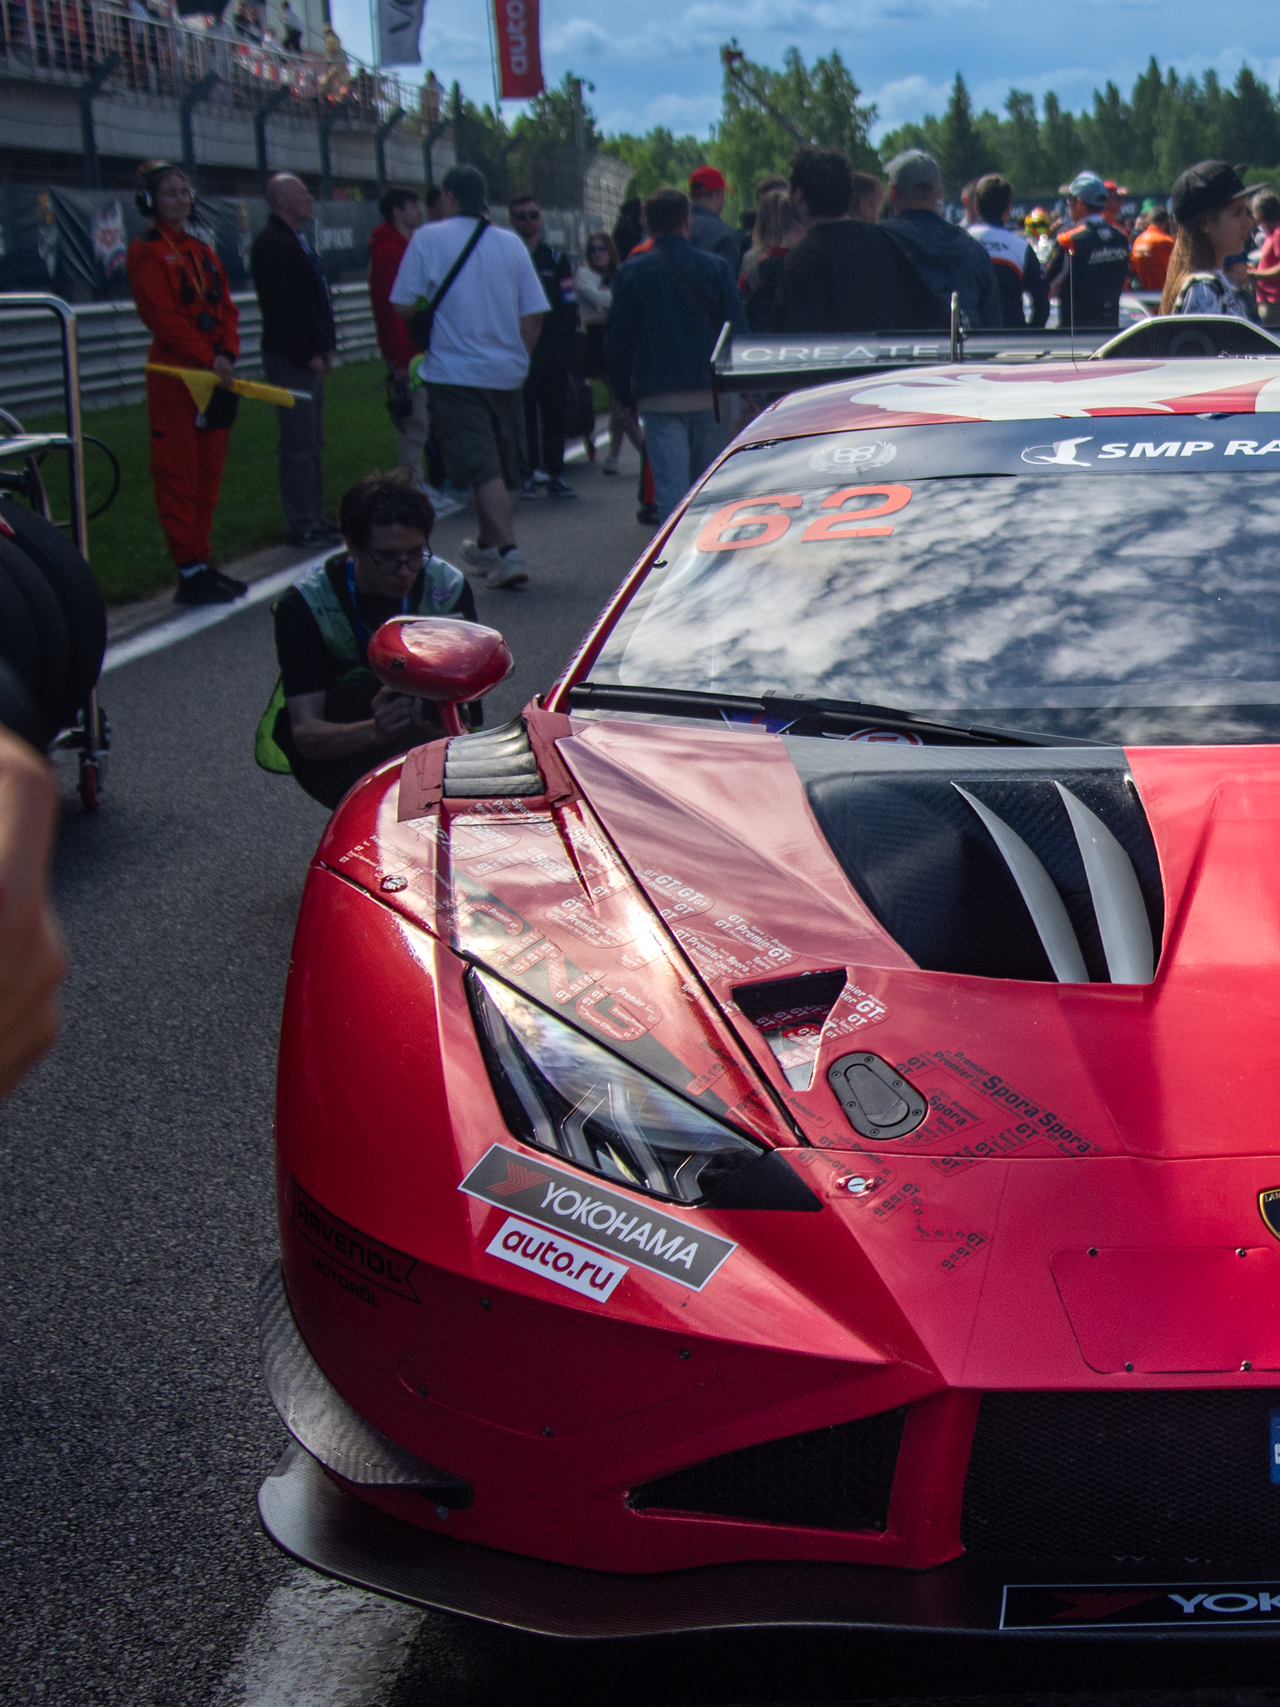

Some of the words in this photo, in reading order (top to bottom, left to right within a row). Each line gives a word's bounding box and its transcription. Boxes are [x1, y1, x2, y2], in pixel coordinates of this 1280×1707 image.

[741, 344, 940, 362] CREATE
[1097, 441, 1214, 460] SMP
[695, 484, 913, 553] 62
[655, 874, 682, 892] GT
[676, 887, 705, 904] GT
[561, 899, 585, 912] GT
[673, 903, 696, 915] GT
[564, 913, 601, 937] Premier
[767, 947, 793, 963] GT
[855, 1000, 886, 1018] GT
[847, 1013, 868, 1027] GT
[907, 1056, 928, 1070] GT
[932, 1050, 975, 1081] Premier
[981, 1074, 1040, 1119] Spora
[927, 1094, 968, 1127] Spora
[1014, 1122, 1041, 1140] GT
[1037, 1112, 1092, 1154] Spora
[902, 1182, 921, 1198] GT
[540, 1181, 699, 1270] YOKOHAMA
[966, 1232, 986, 1248] GT
[501, 1229, 615, 1291] auto.ru
